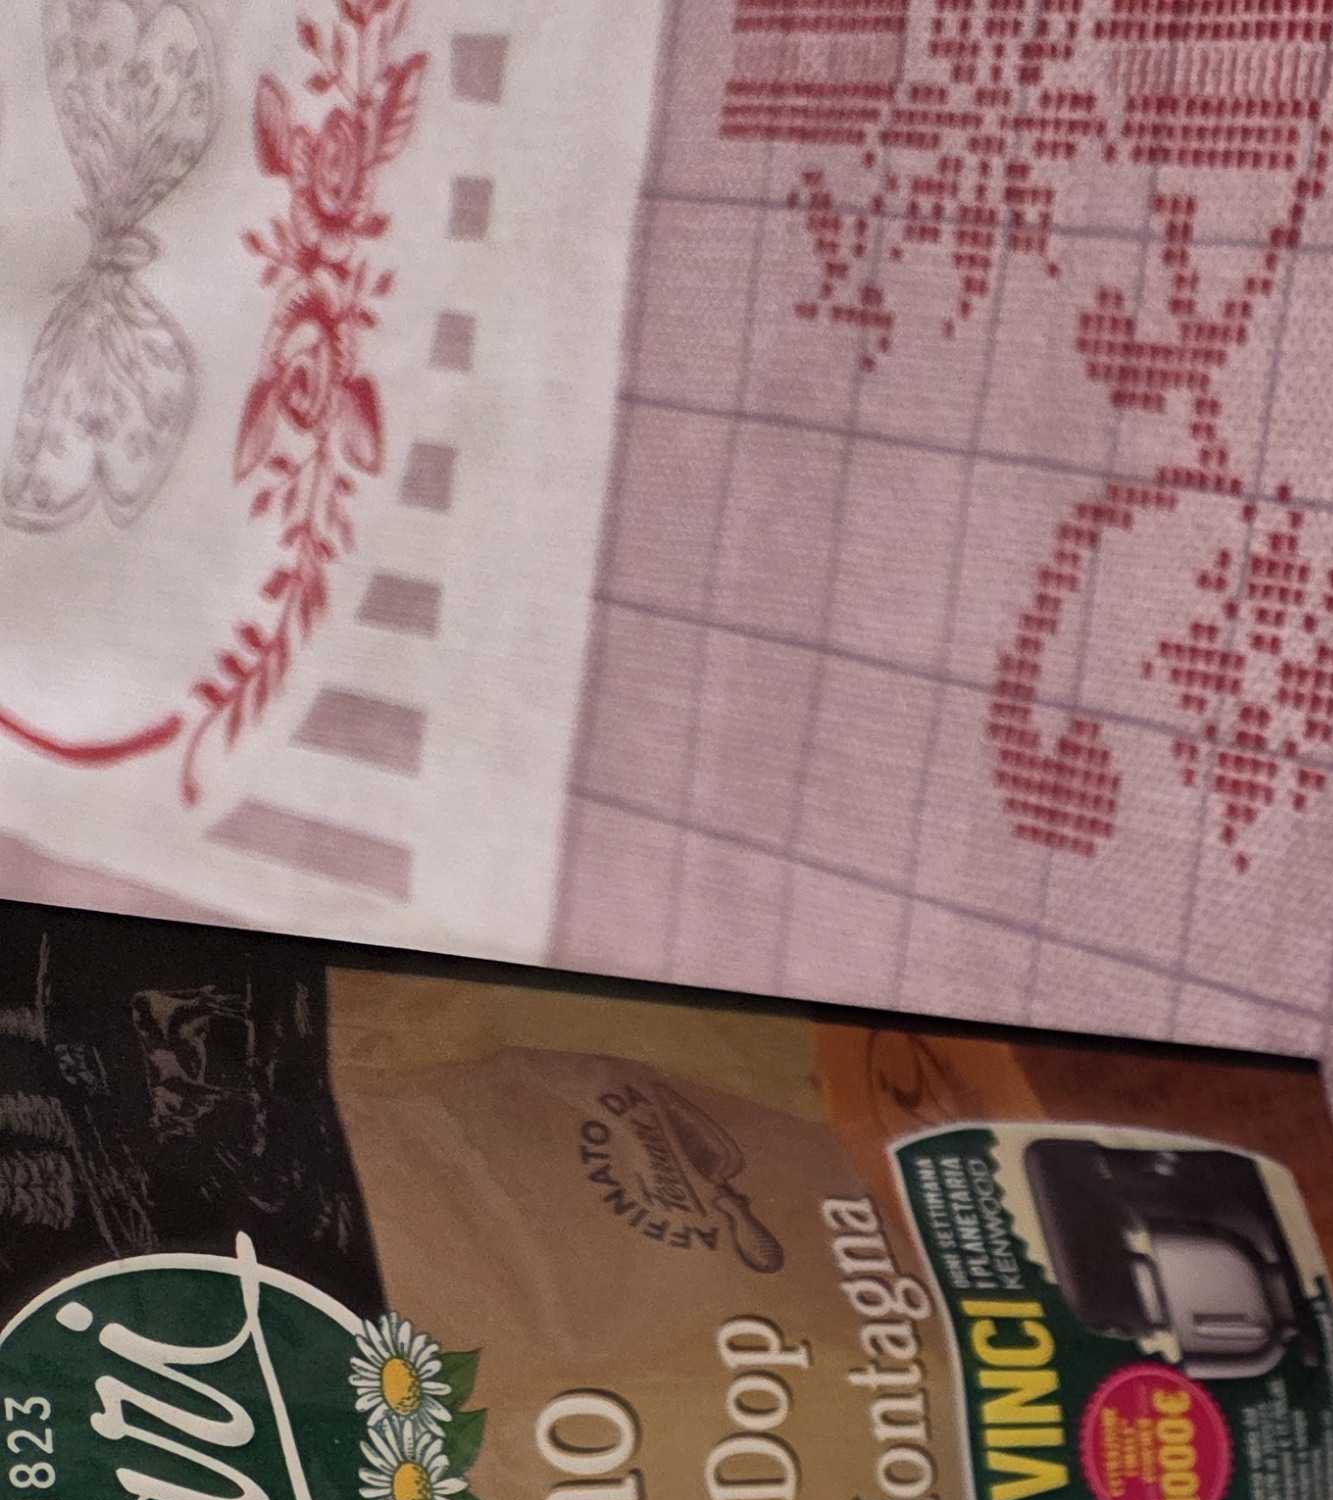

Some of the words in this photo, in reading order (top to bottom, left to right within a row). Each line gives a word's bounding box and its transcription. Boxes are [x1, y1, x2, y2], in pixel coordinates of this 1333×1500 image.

[578, 1119, 719, 1250] AFFINATO
[914, 1158, 957, 1248] SETTIMANA
[940, 1158, 994, 1277] PLANETARIA
[968, 1159, 1025, 1289] KENWOOD
